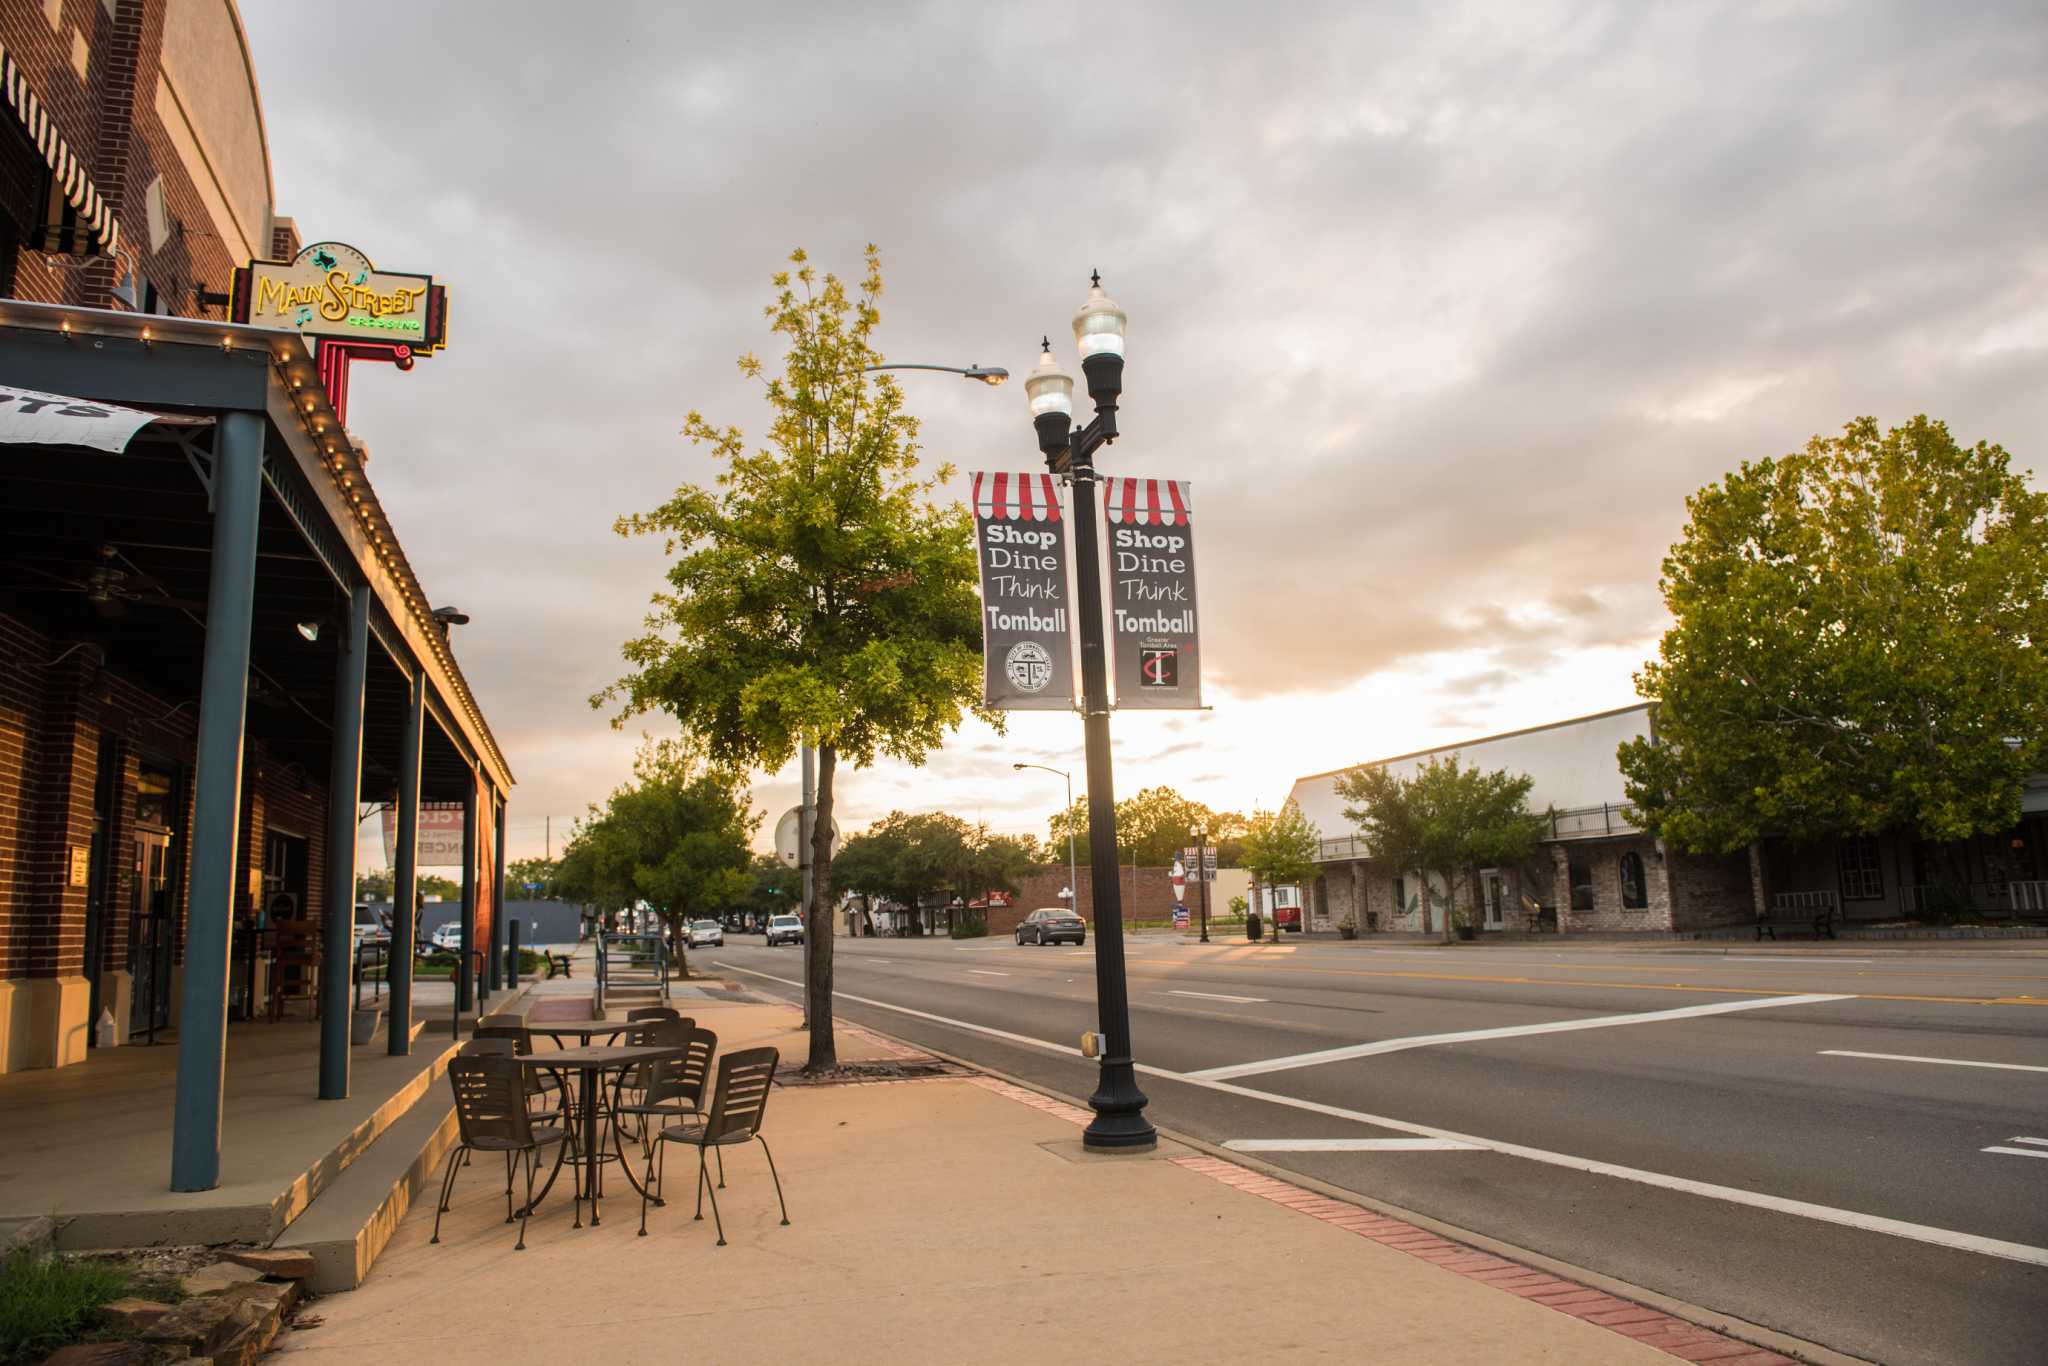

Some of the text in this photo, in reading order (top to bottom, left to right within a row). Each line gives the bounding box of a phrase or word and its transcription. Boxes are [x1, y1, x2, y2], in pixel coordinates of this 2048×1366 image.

[348, 316, 420, 330] CROSSING
[986, 524, 1057, 550] Shop
[1116, 529, 1185, 554] Shop
[988, 547, 1058, 571] Dine
[1118, 551, 1186, 574] Dine
[991, 575, 1060, 600] Think
[1119, 578, 1188, 601] Think
[987, 606, 1066, 633] Tomball
[1115, 609, 1194, 634] Tomball
